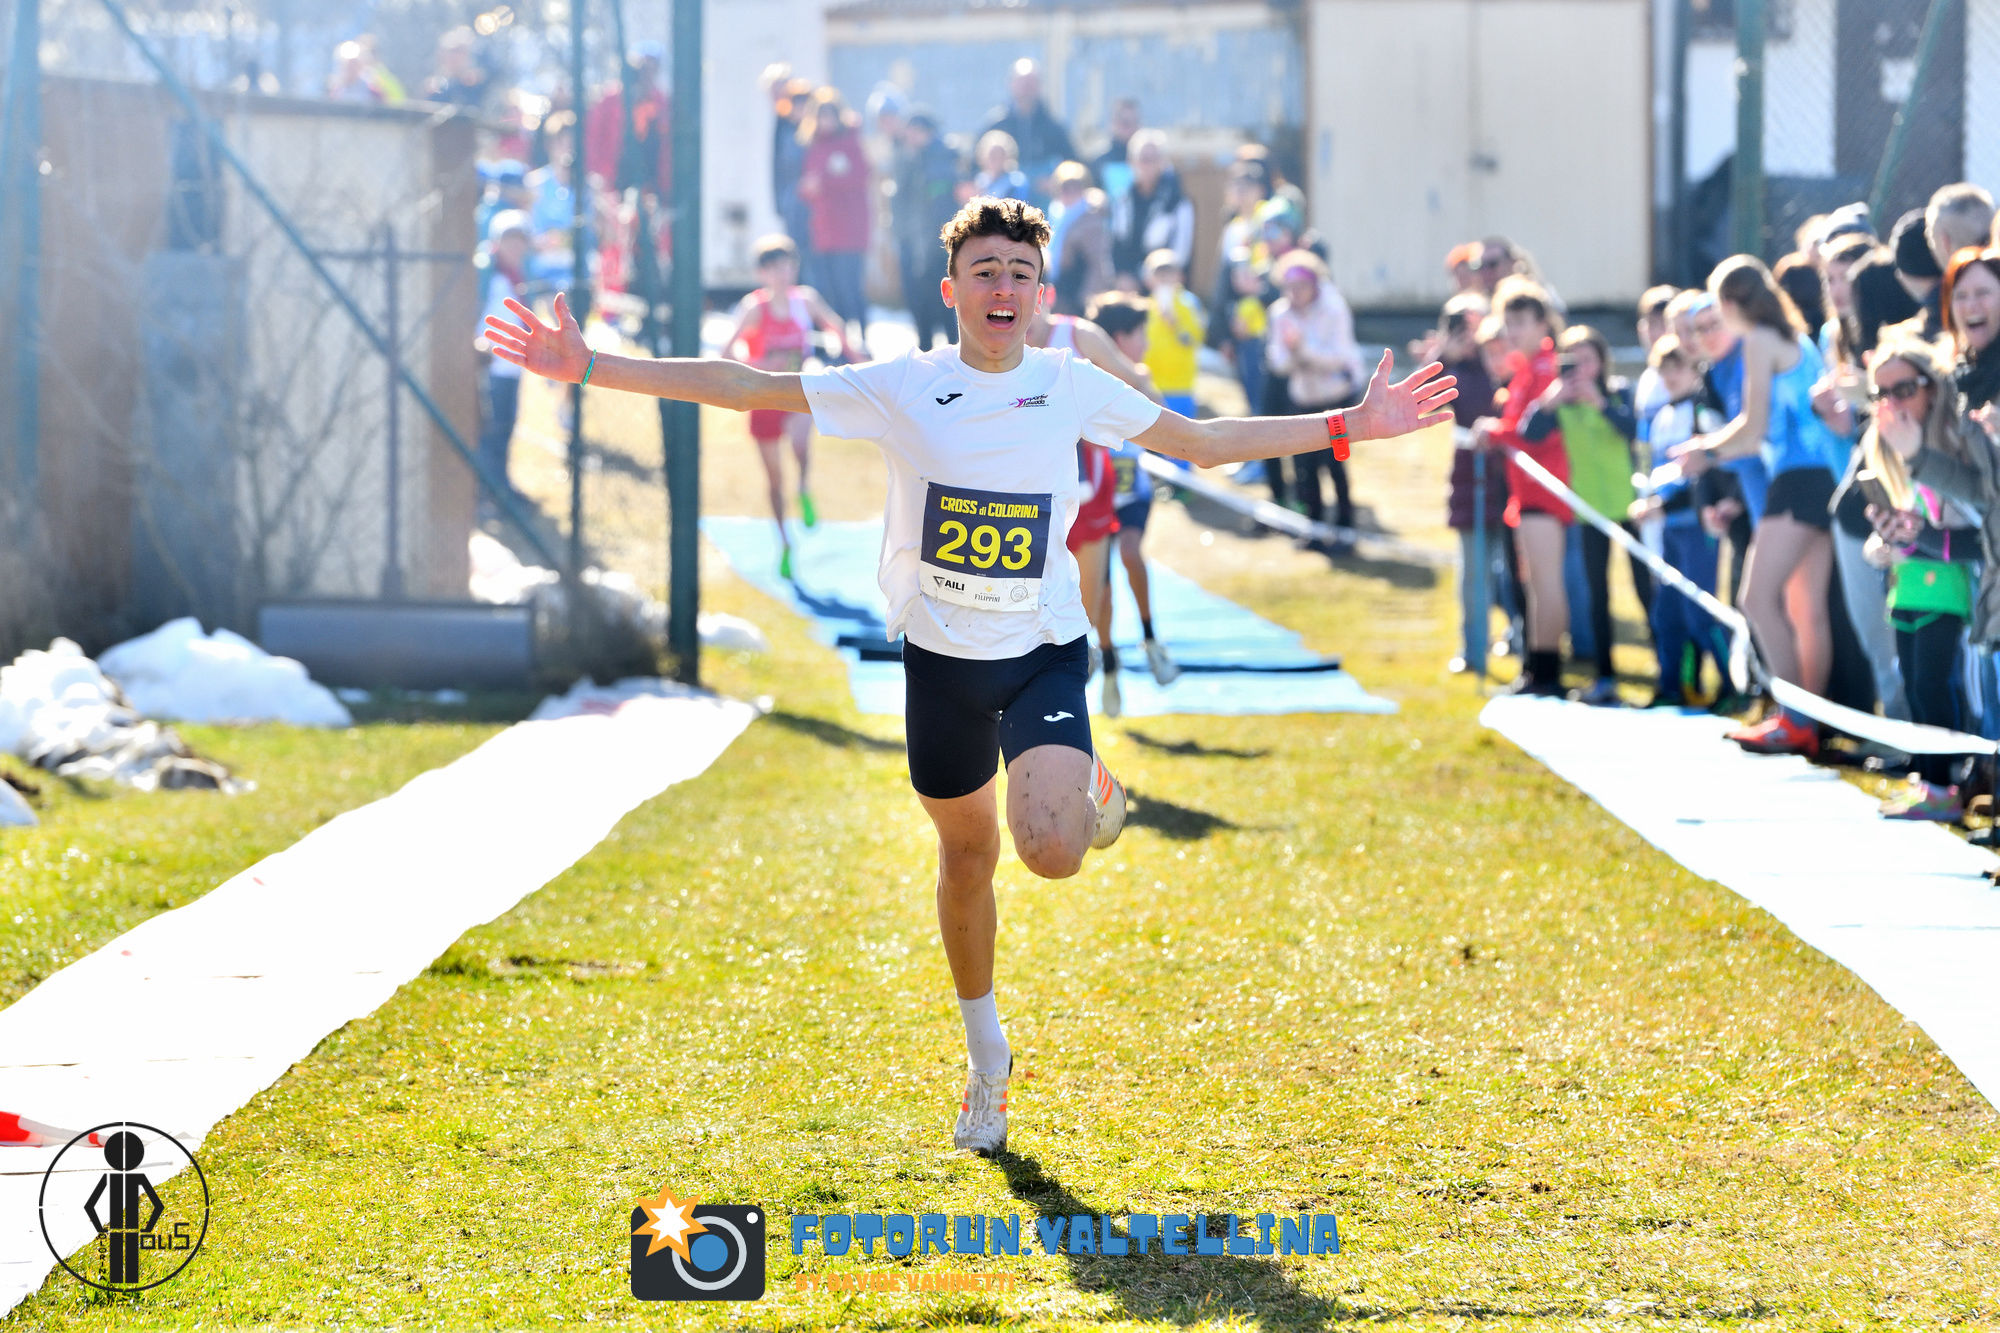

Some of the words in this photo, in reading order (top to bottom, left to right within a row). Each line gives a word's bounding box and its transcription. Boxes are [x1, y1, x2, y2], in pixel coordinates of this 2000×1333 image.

[940, 496, 978, 515] CROSS
[979, 507, 987, 516] di
[988, 502, 1039, 519] COLORINA
[935, 520, 1033, 571] 293
[944, 579, 965, 591] AILI
